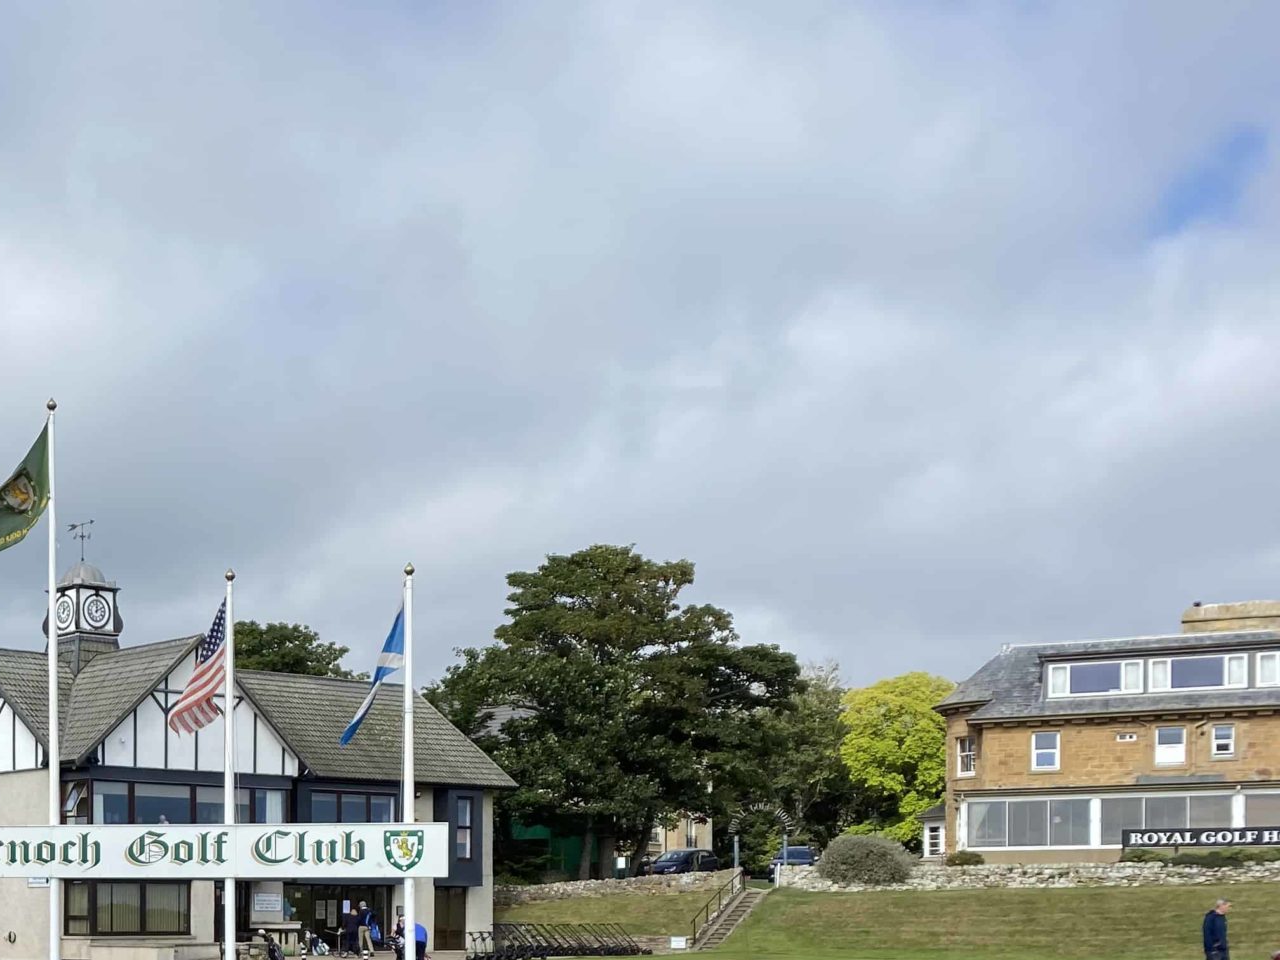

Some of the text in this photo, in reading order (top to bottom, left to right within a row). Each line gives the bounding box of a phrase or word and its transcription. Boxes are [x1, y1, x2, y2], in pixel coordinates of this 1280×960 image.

[125, 830, 229, 866] Golf
[251, 829, 365, 865] Club
[1129, 830, 1280, 845] ROYAL GOLF H
